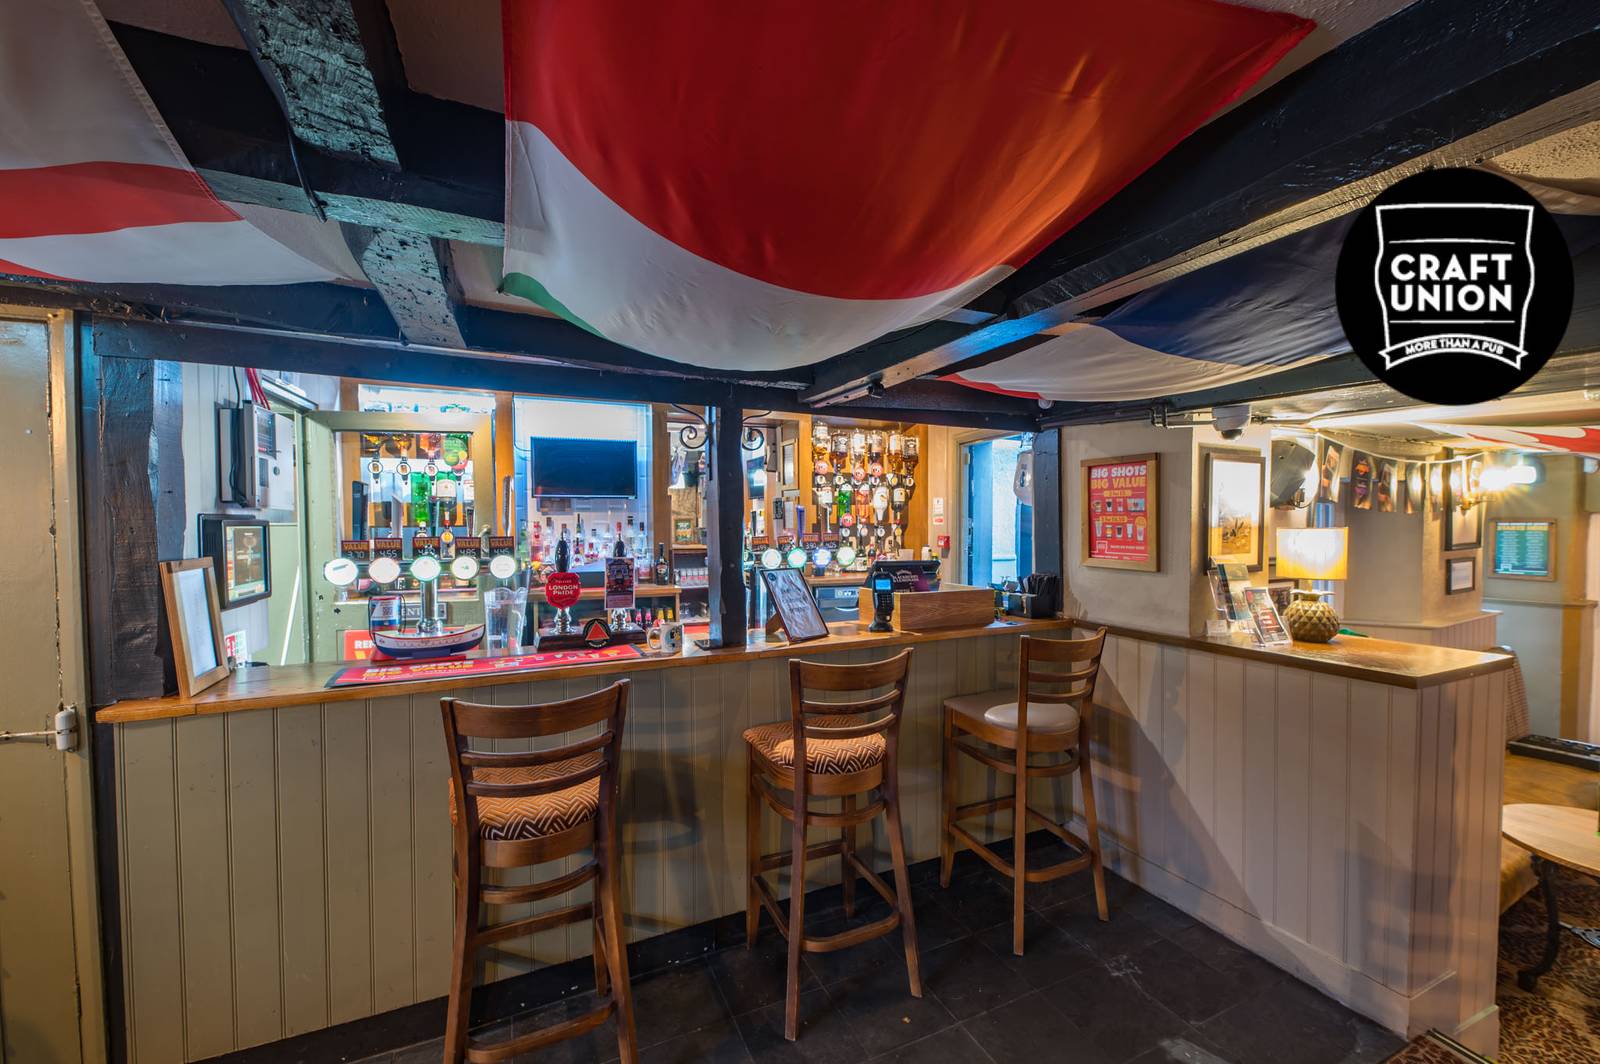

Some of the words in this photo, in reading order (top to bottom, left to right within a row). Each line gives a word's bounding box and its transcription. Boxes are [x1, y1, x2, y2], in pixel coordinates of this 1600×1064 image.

[1091, 468, 1109, 479] BIG
[1111, 465, 1147, 477] SHOTS
[1091, 478, 1109, 489] BIG
[1112, 477, 1146, 488] VALUE
[376, 541, 401, 549] VALUE
